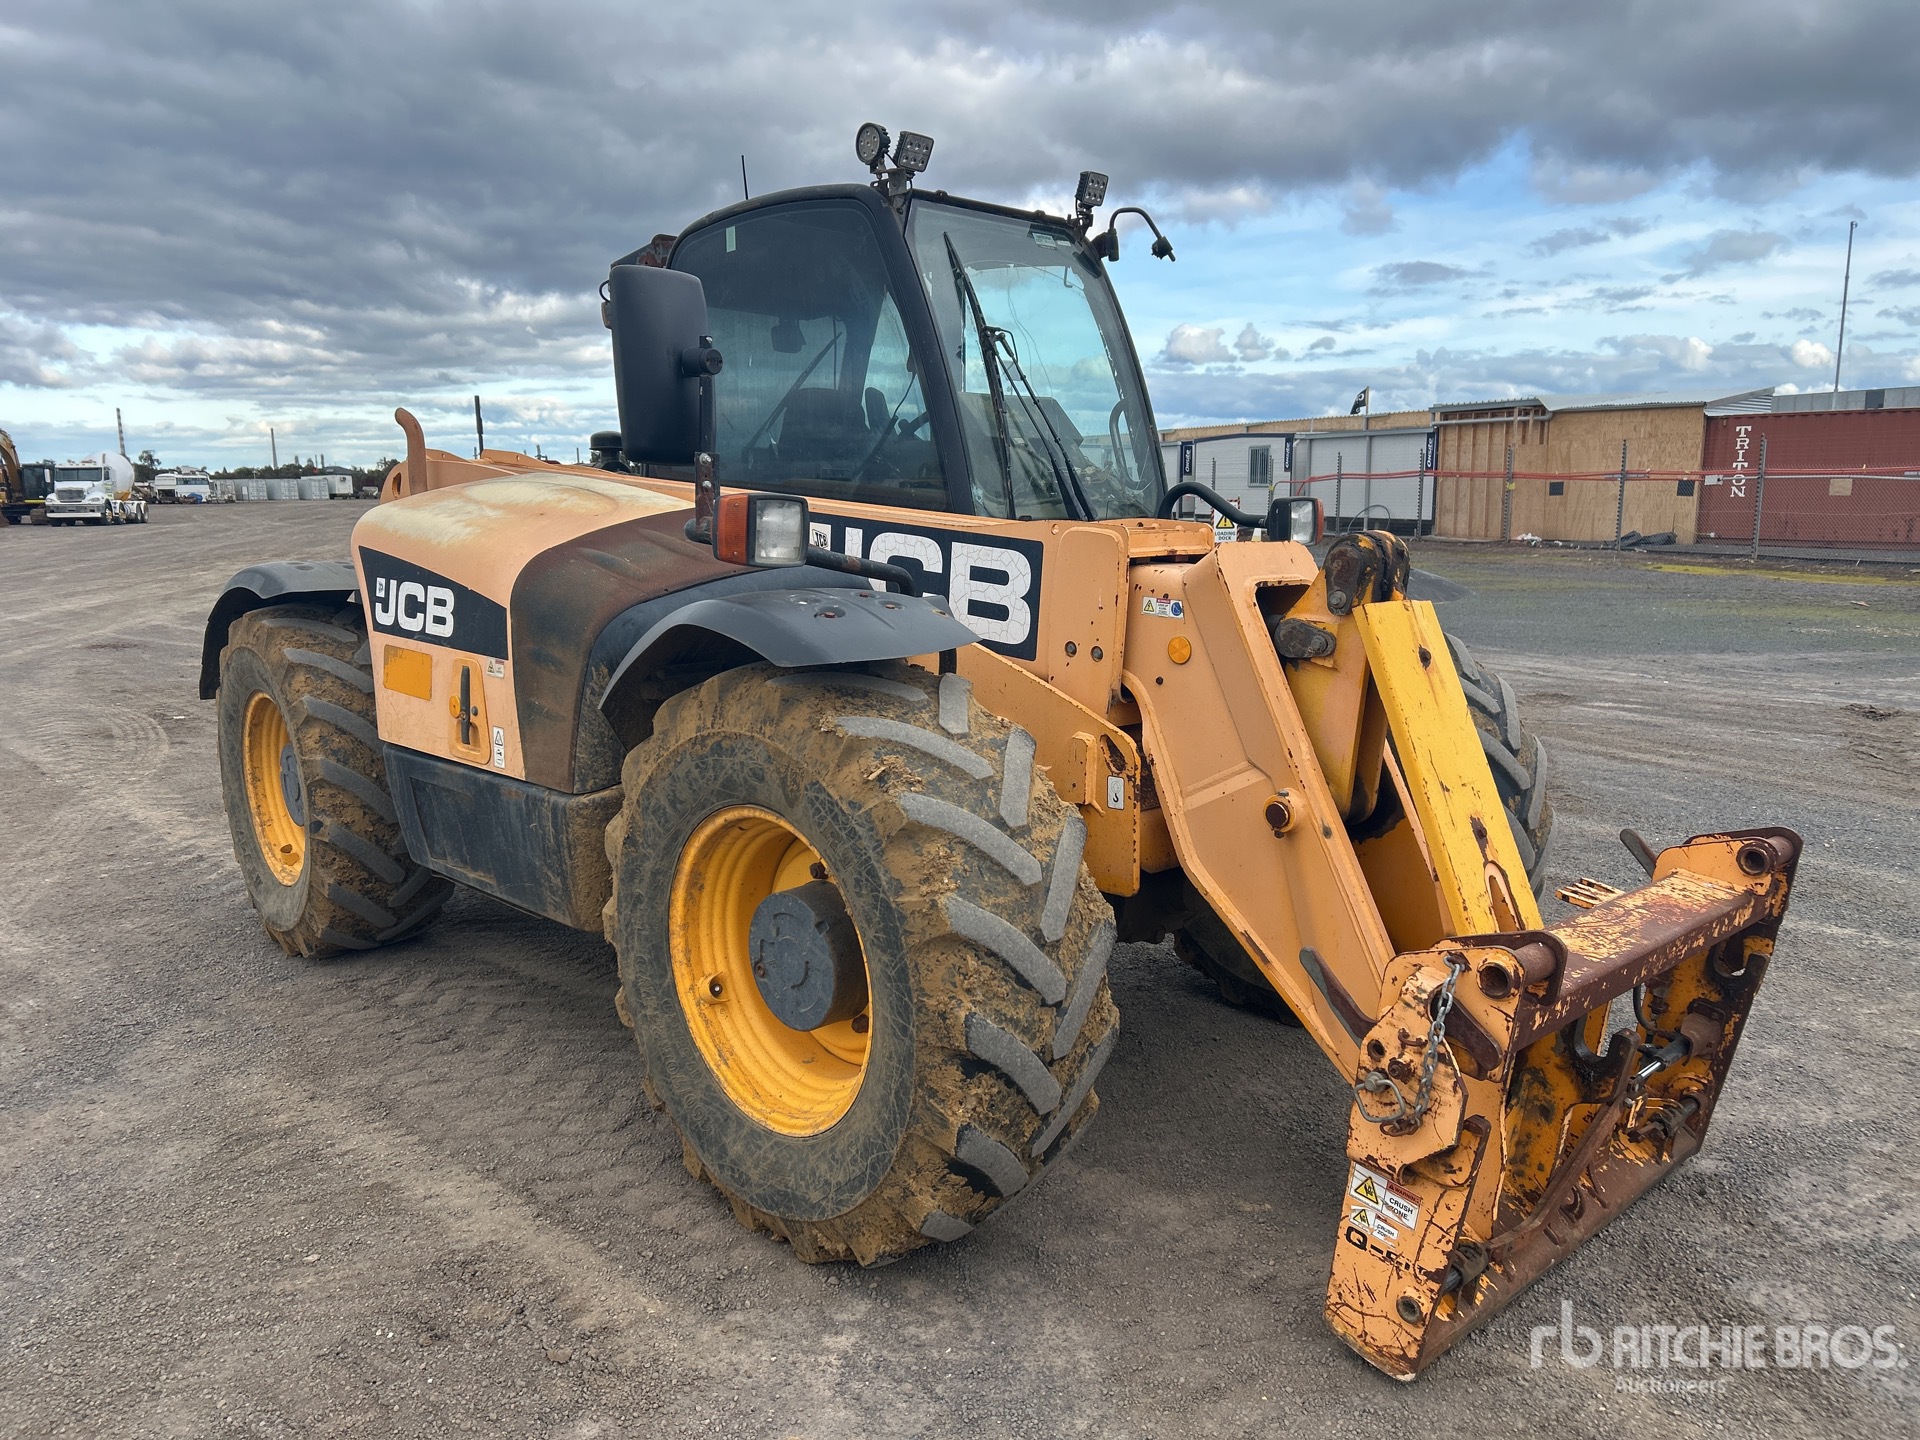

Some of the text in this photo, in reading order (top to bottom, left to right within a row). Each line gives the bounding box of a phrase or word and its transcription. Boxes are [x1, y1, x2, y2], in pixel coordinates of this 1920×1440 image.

[1730, 425, 1752, 498] TRITON
[375, 577, 455, 638] JCB
[1389, 1197, 1414, 1215] CRUSH
[1376, 1223, 1395, 1237] CRUSH
